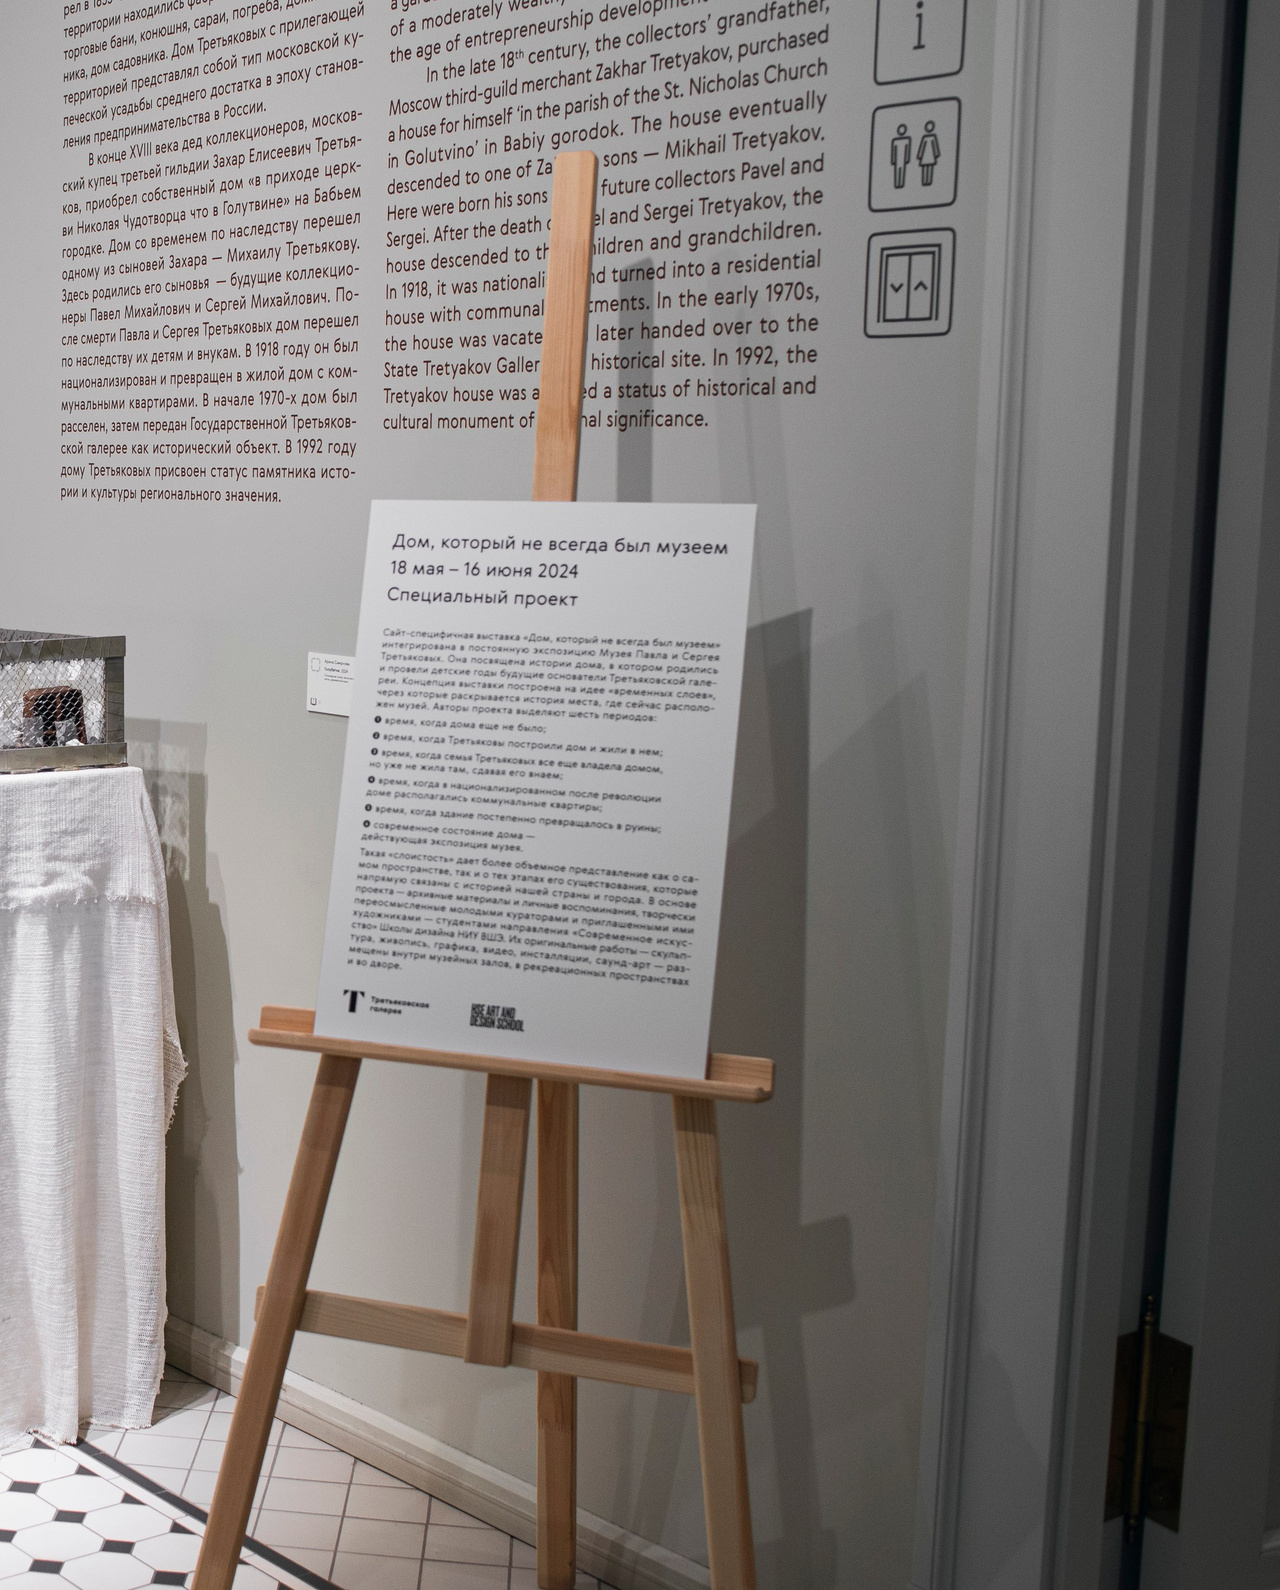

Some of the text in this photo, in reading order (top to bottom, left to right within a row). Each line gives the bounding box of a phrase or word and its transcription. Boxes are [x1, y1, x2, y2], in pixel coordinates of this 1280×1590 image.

[389, 28, 828, 117] Moscow third-guild merchant Zakhar Tretyakov, purchased
[388, 153, 824, 222] Here were born his sons future collectors Pavel and
[62, 337, 358, 368] по наследству их детям и внукам. В 1918 году он был
[383, 413, 432, 430] cultural
[438, 414, 514, 429] monument
[520, 410, 535, 429] of
[607, 408, 708, 433] significance.
[61, 438, 356, 458] ской галерее как исторический объект. В 1992 году
[61, 463, 355, 481] дому Третьяковых присвоен статус памятника исто-
[61, 487, 281, 503] рии и культуры регионального значения.
[392, 534, 727, 557] Дом, который не всегда был музеем
[392, 560, 406, 575] 18
[413, 564, 444, 576] мая
[465, 561, 480, 576] 16
[487, 566, 532, 578] июня
[538, 563, 578, 579] 2024
[388, 586, 578, 608] Специальный проект
[384, 716, 545, 734] время, когда дома еще не было;
[370, 1006, 402, 1015] галерея
[371, 995, 430, 1009] Третьяковская
[471, 1003, 516, 1019] HSE ART AND
[470, 1015, 525, 1032] DESIGN SCHOOL
